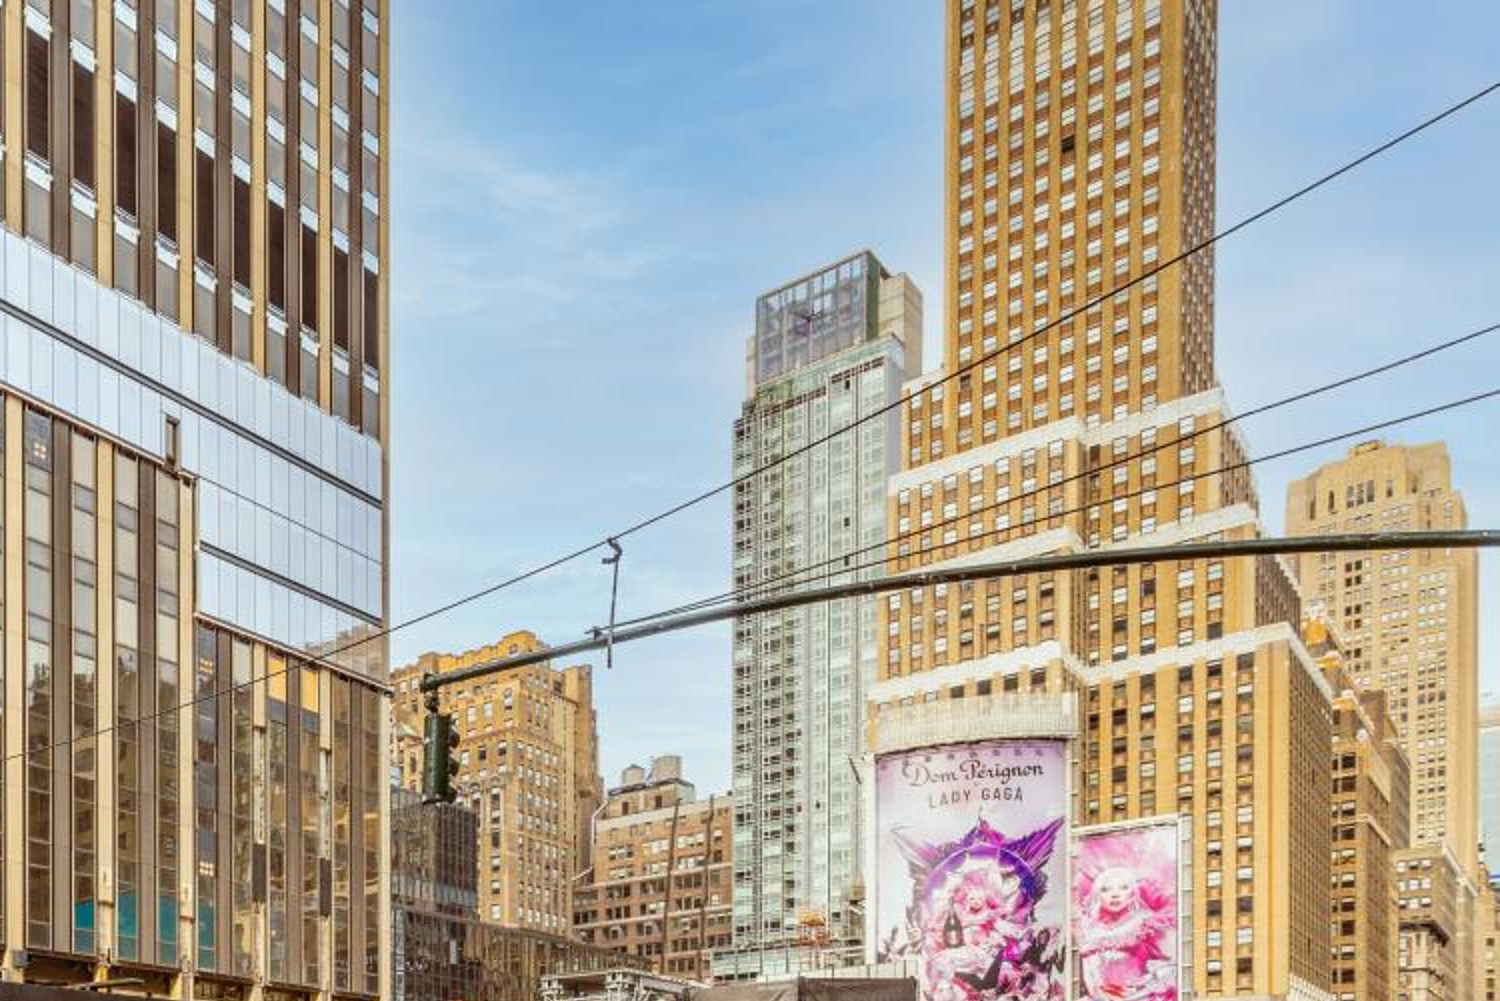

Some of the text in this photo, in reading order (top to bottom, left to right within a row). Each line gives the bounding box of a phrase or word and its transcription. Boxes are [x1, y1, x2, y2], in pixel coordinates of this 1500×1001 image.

[959, 759, 1045, 785] Pérignon
[929, 787, 1024, 809] LADY GAGA
